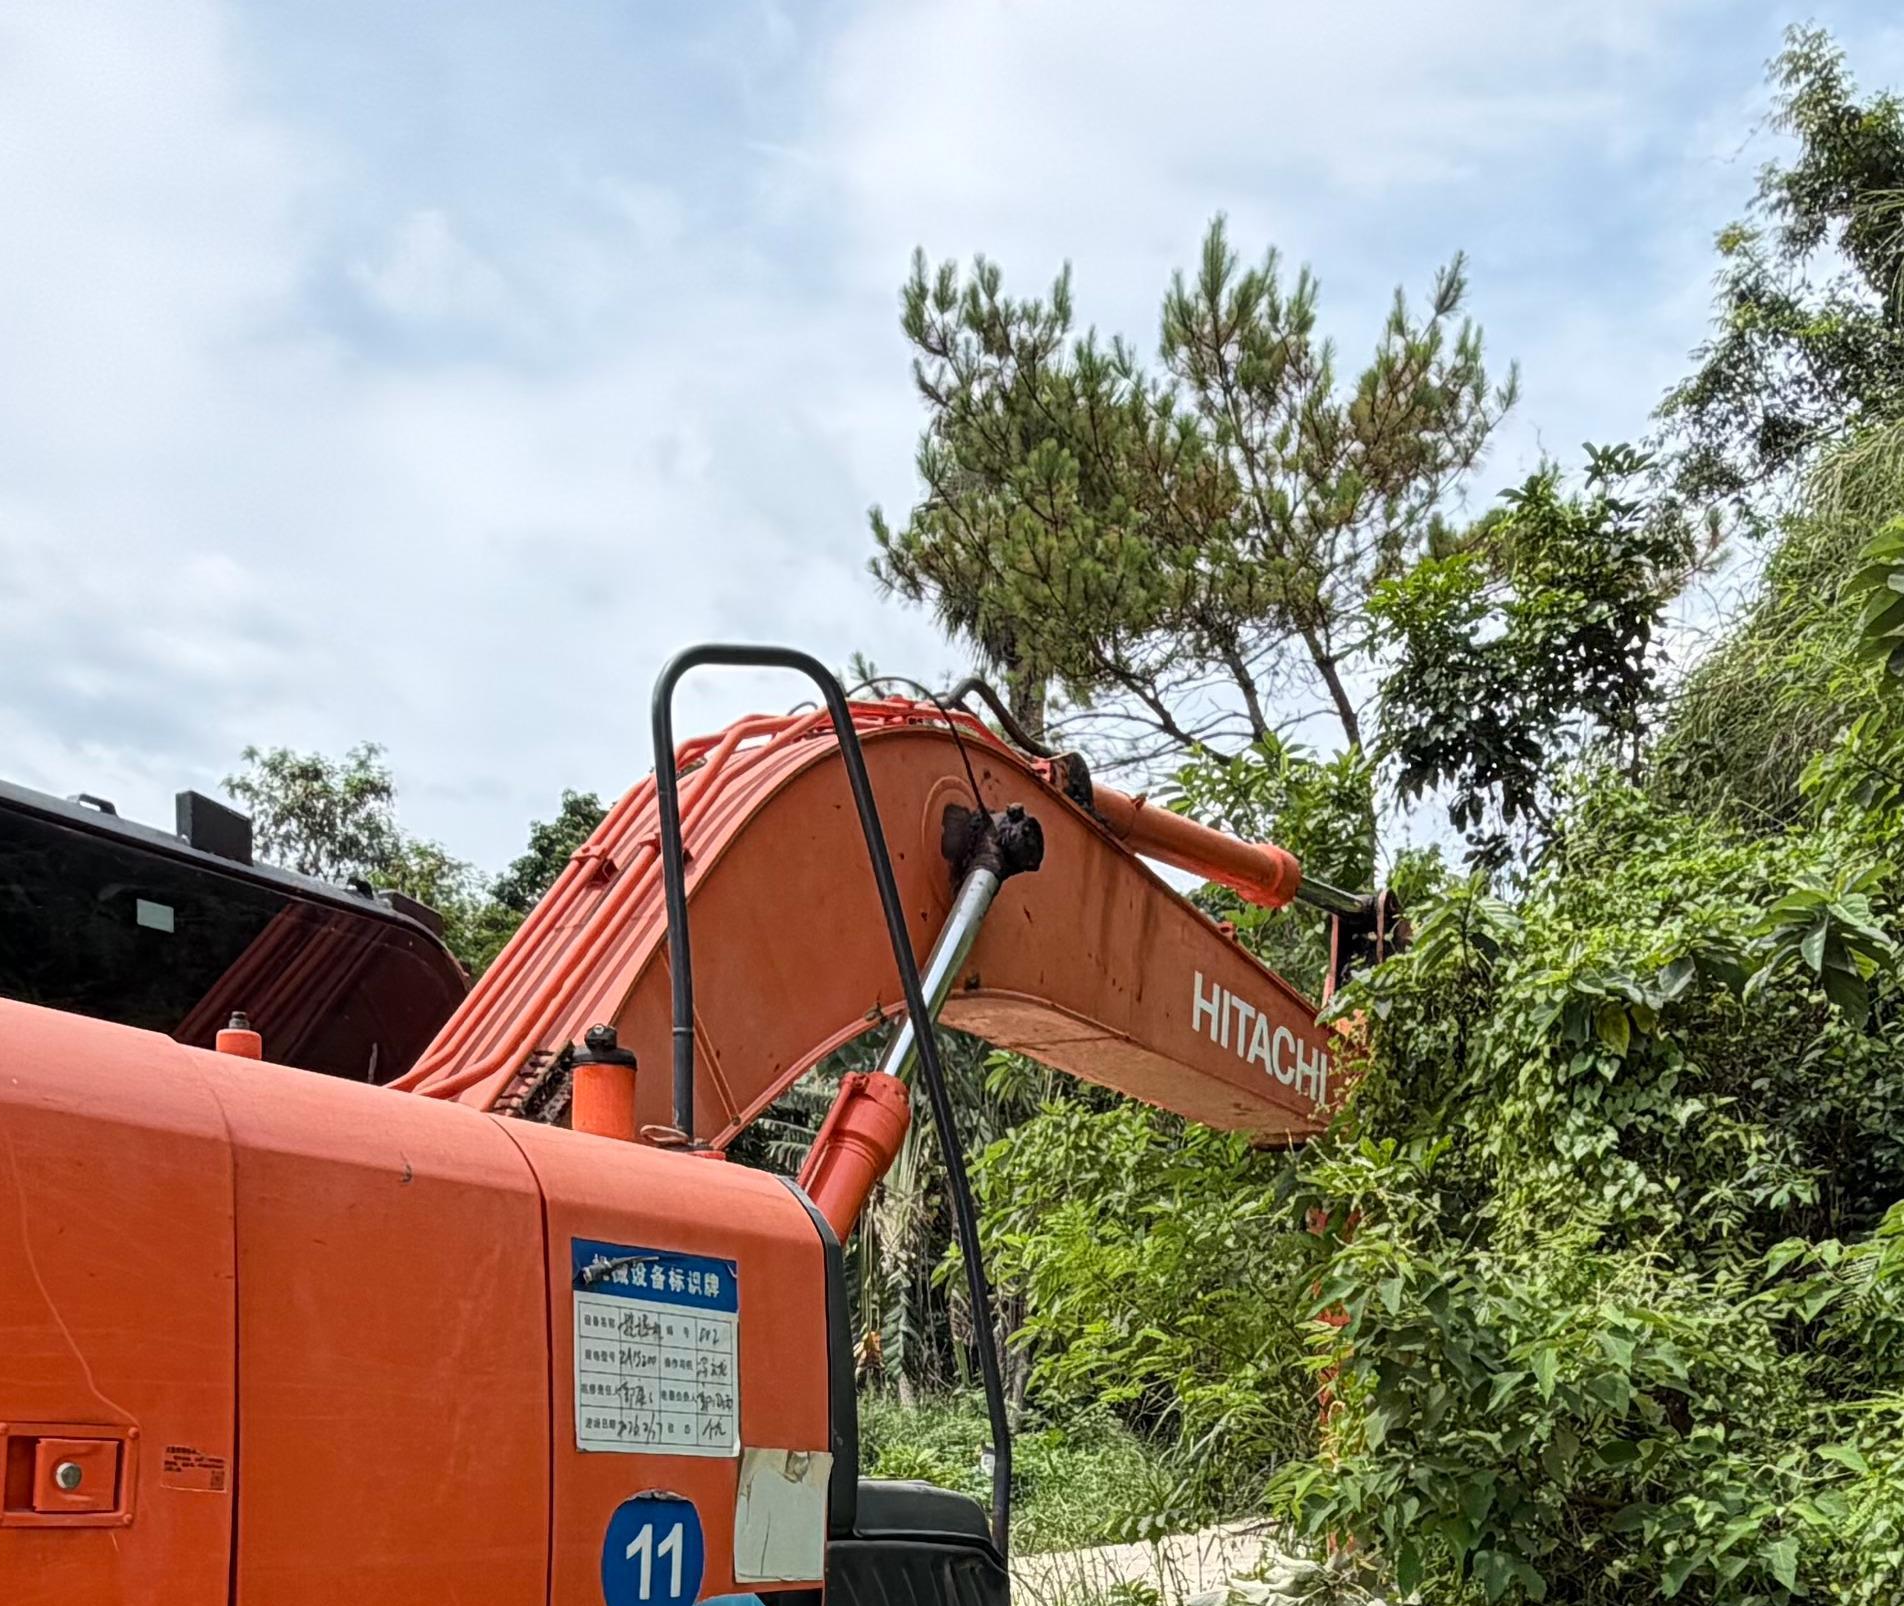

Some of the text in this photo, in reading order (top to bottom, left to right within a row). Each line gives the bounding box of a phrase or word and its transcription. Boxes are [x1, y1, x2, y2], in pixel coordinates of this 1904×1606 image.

[1192, 971, 1327, 1105] HITACHI
[593, 1254, 720, 1298] 械设备标识牌
[626, 1522, 683, 1600] 11
